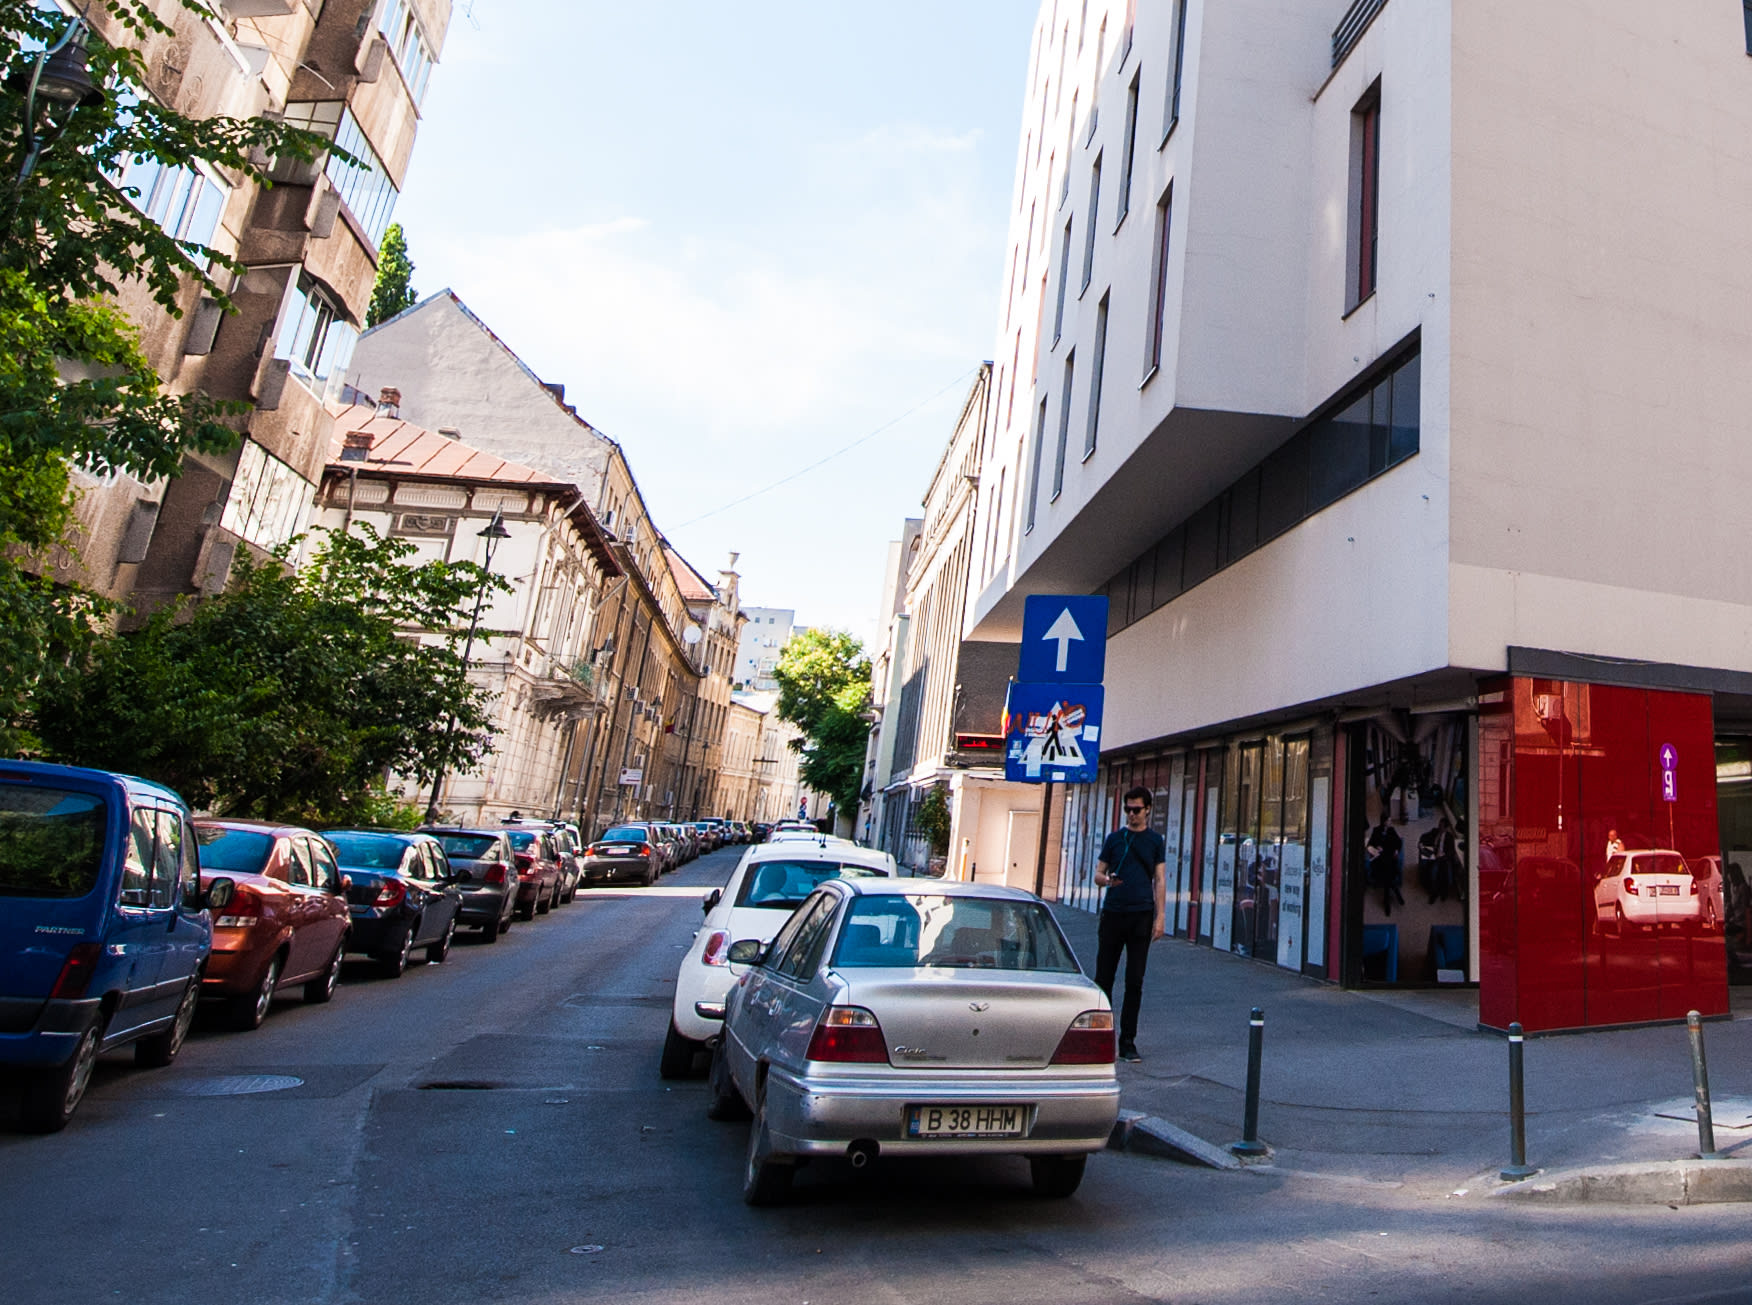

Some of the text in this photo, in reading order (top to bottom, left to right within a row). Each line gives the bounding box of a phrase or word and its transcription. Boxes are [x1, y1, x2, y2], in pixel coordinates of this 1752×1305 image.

[927, 1108, 1017, 1131] B 38 HHM
